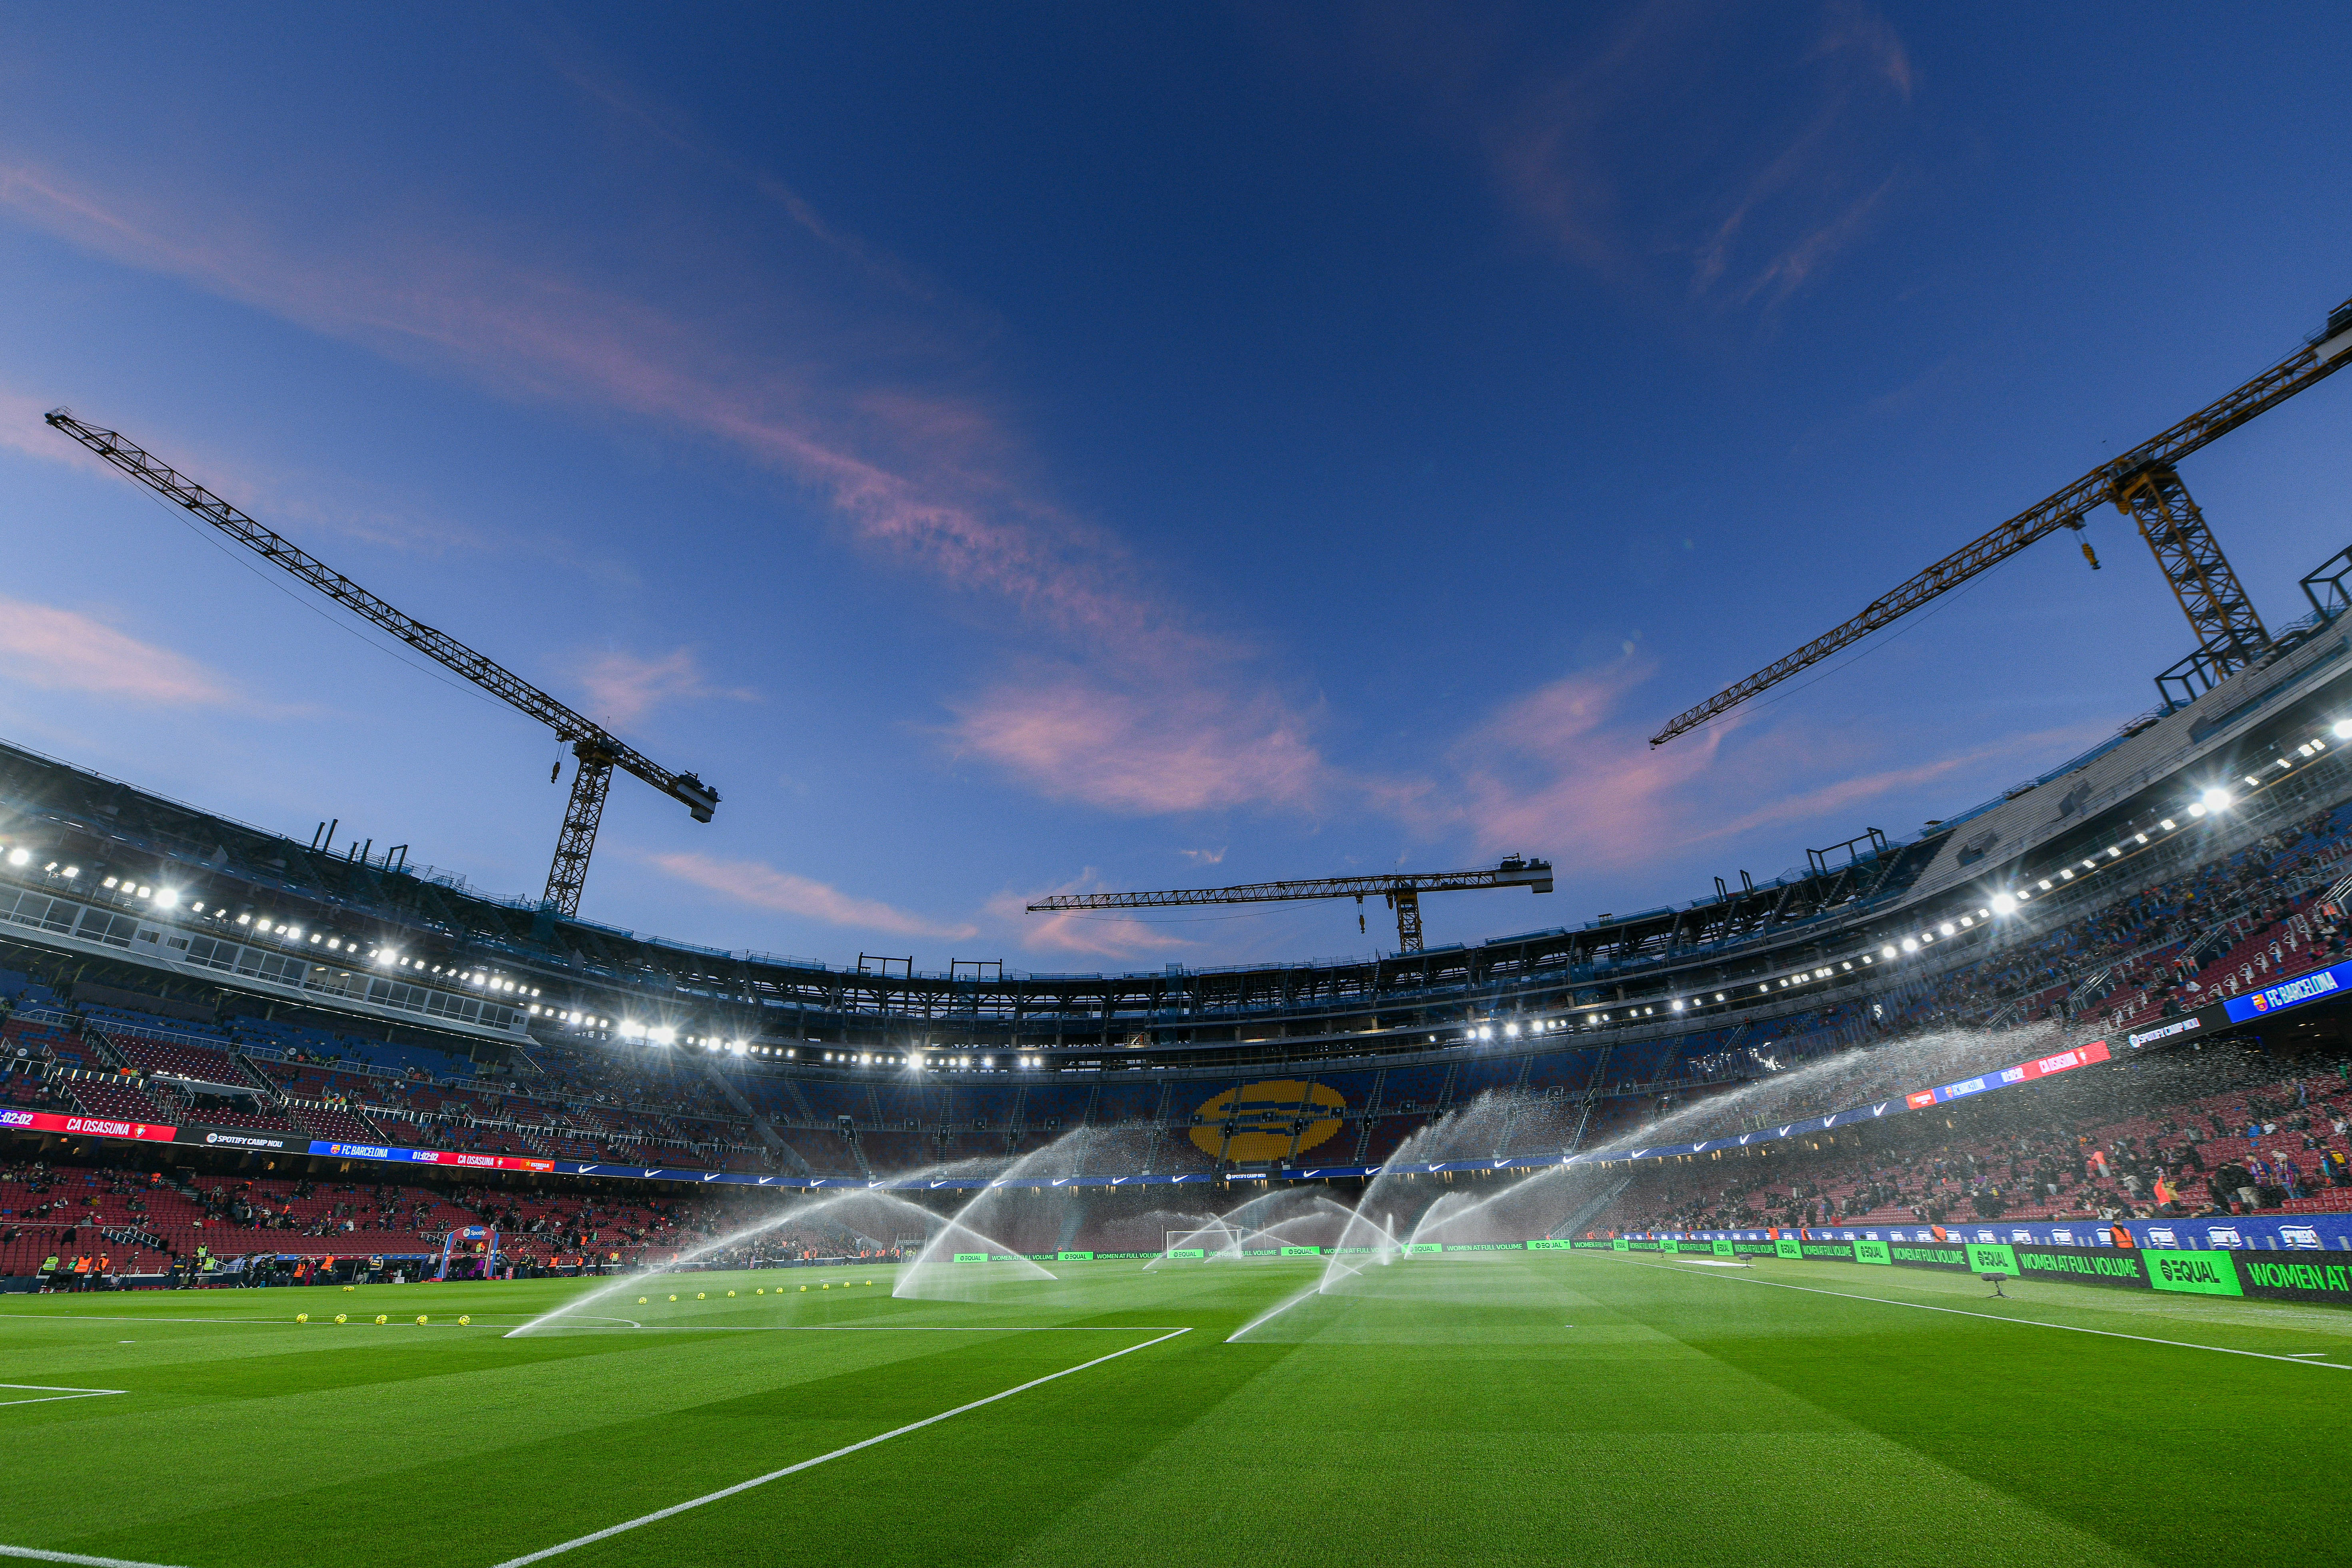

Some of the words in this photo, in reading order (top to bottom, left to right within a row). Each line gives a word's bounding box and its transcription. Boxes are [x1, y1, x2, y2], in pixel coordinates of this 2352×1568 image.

[2265, 989, 2283, 1007] FC
[2277, 972, 2339, 1003] BARCELONA
[2138, 1028, 2166, 1043] SPOTIFY
[2163, 1022, 2184, 1036] CAMP
[2182, 1017, 2201, 1030] NOU
[66, 1118, 82, 1131] CA
[82, 1120, 130, 1135] OSASUNA
[217, 1135, 247, 1145] SPOTIFY
[247, 1138, 268, 1147] CAMP
[341, 1145, 351, 1155] FC
[351, 1146, 388, 1158] BARCELONA
[412, 1151, 439, 1161] 01:02:02
[457, 1155, 467, 1164] CA
[467, 1156, 494, 1166] OSASUNA
[1802, 1245, 1820, 1255] WOMEN
[1823, 1246, 1834, 1256] FULL
[1832, 1246, 1853, 1257] VOLUME
[1864, 1246, 1883, 1258] EQUAL
[1892, 1248, 1917, 1260] WOMEN
[1915, 1248, 1923, 1261] AT
[1920, 1249, 1938, 1262] FULL
[1935, 1249, 1965, 1264] VOLUME
[1983, 1251, 2009, 1267] EQUAL
[2019, 1253, 2058, 1271] WOMEN
[2057, 1255, 2069, 1272] AT
[2068, 1256, 2095, 1274] FULL
[2090, 1257, 2140, 1278] VOLUME
[2171, 1260, 2220, 1283] EQUAL
[2246, 1263, 2327, 1290] WOMEN
[2325, 1265, 2350, 1291] AT
